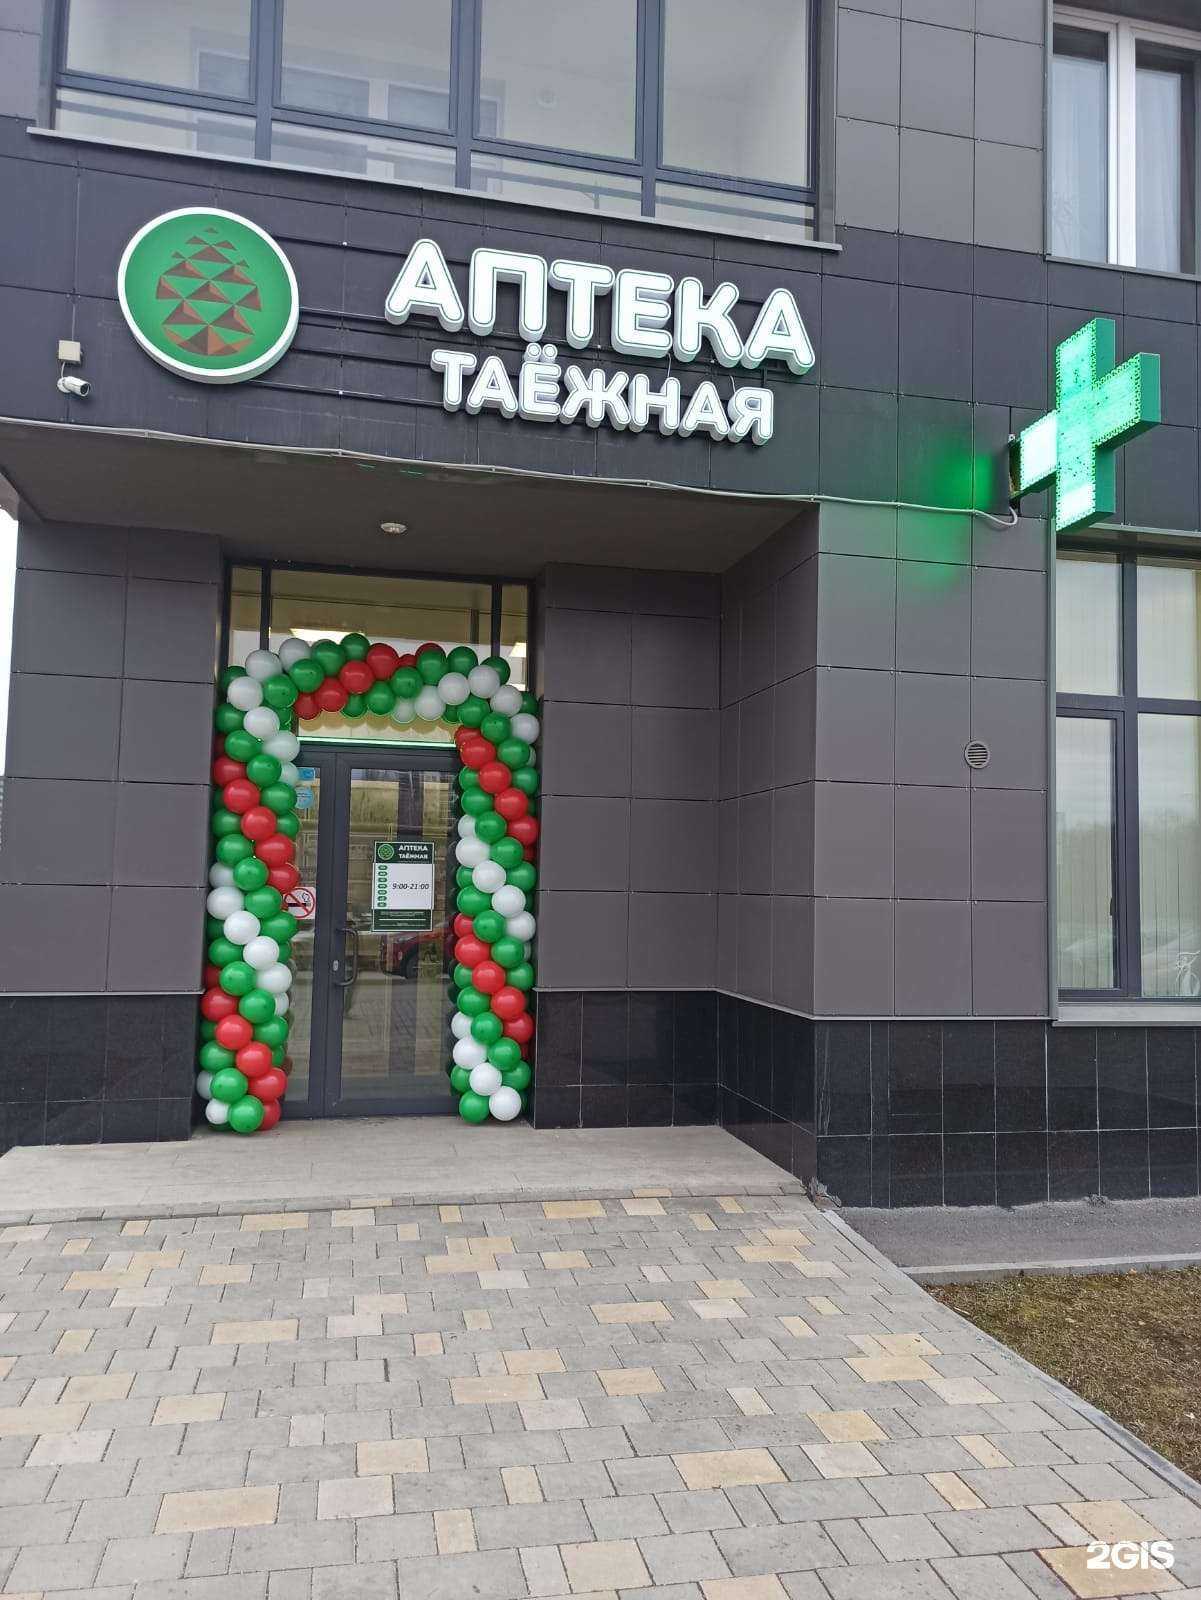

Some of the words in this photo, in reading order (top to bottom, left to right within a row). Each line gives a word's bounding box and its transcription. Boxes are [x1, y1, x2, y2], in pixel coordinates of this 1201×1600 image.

[385, 238, 815, 375] АПТЕКА
[430, 342, 774, 446] ТАЁЖНАЯ
[398, 844, 428, 852] АПТЕКА
[392, 882, 430, 890] 9:00-21:00
